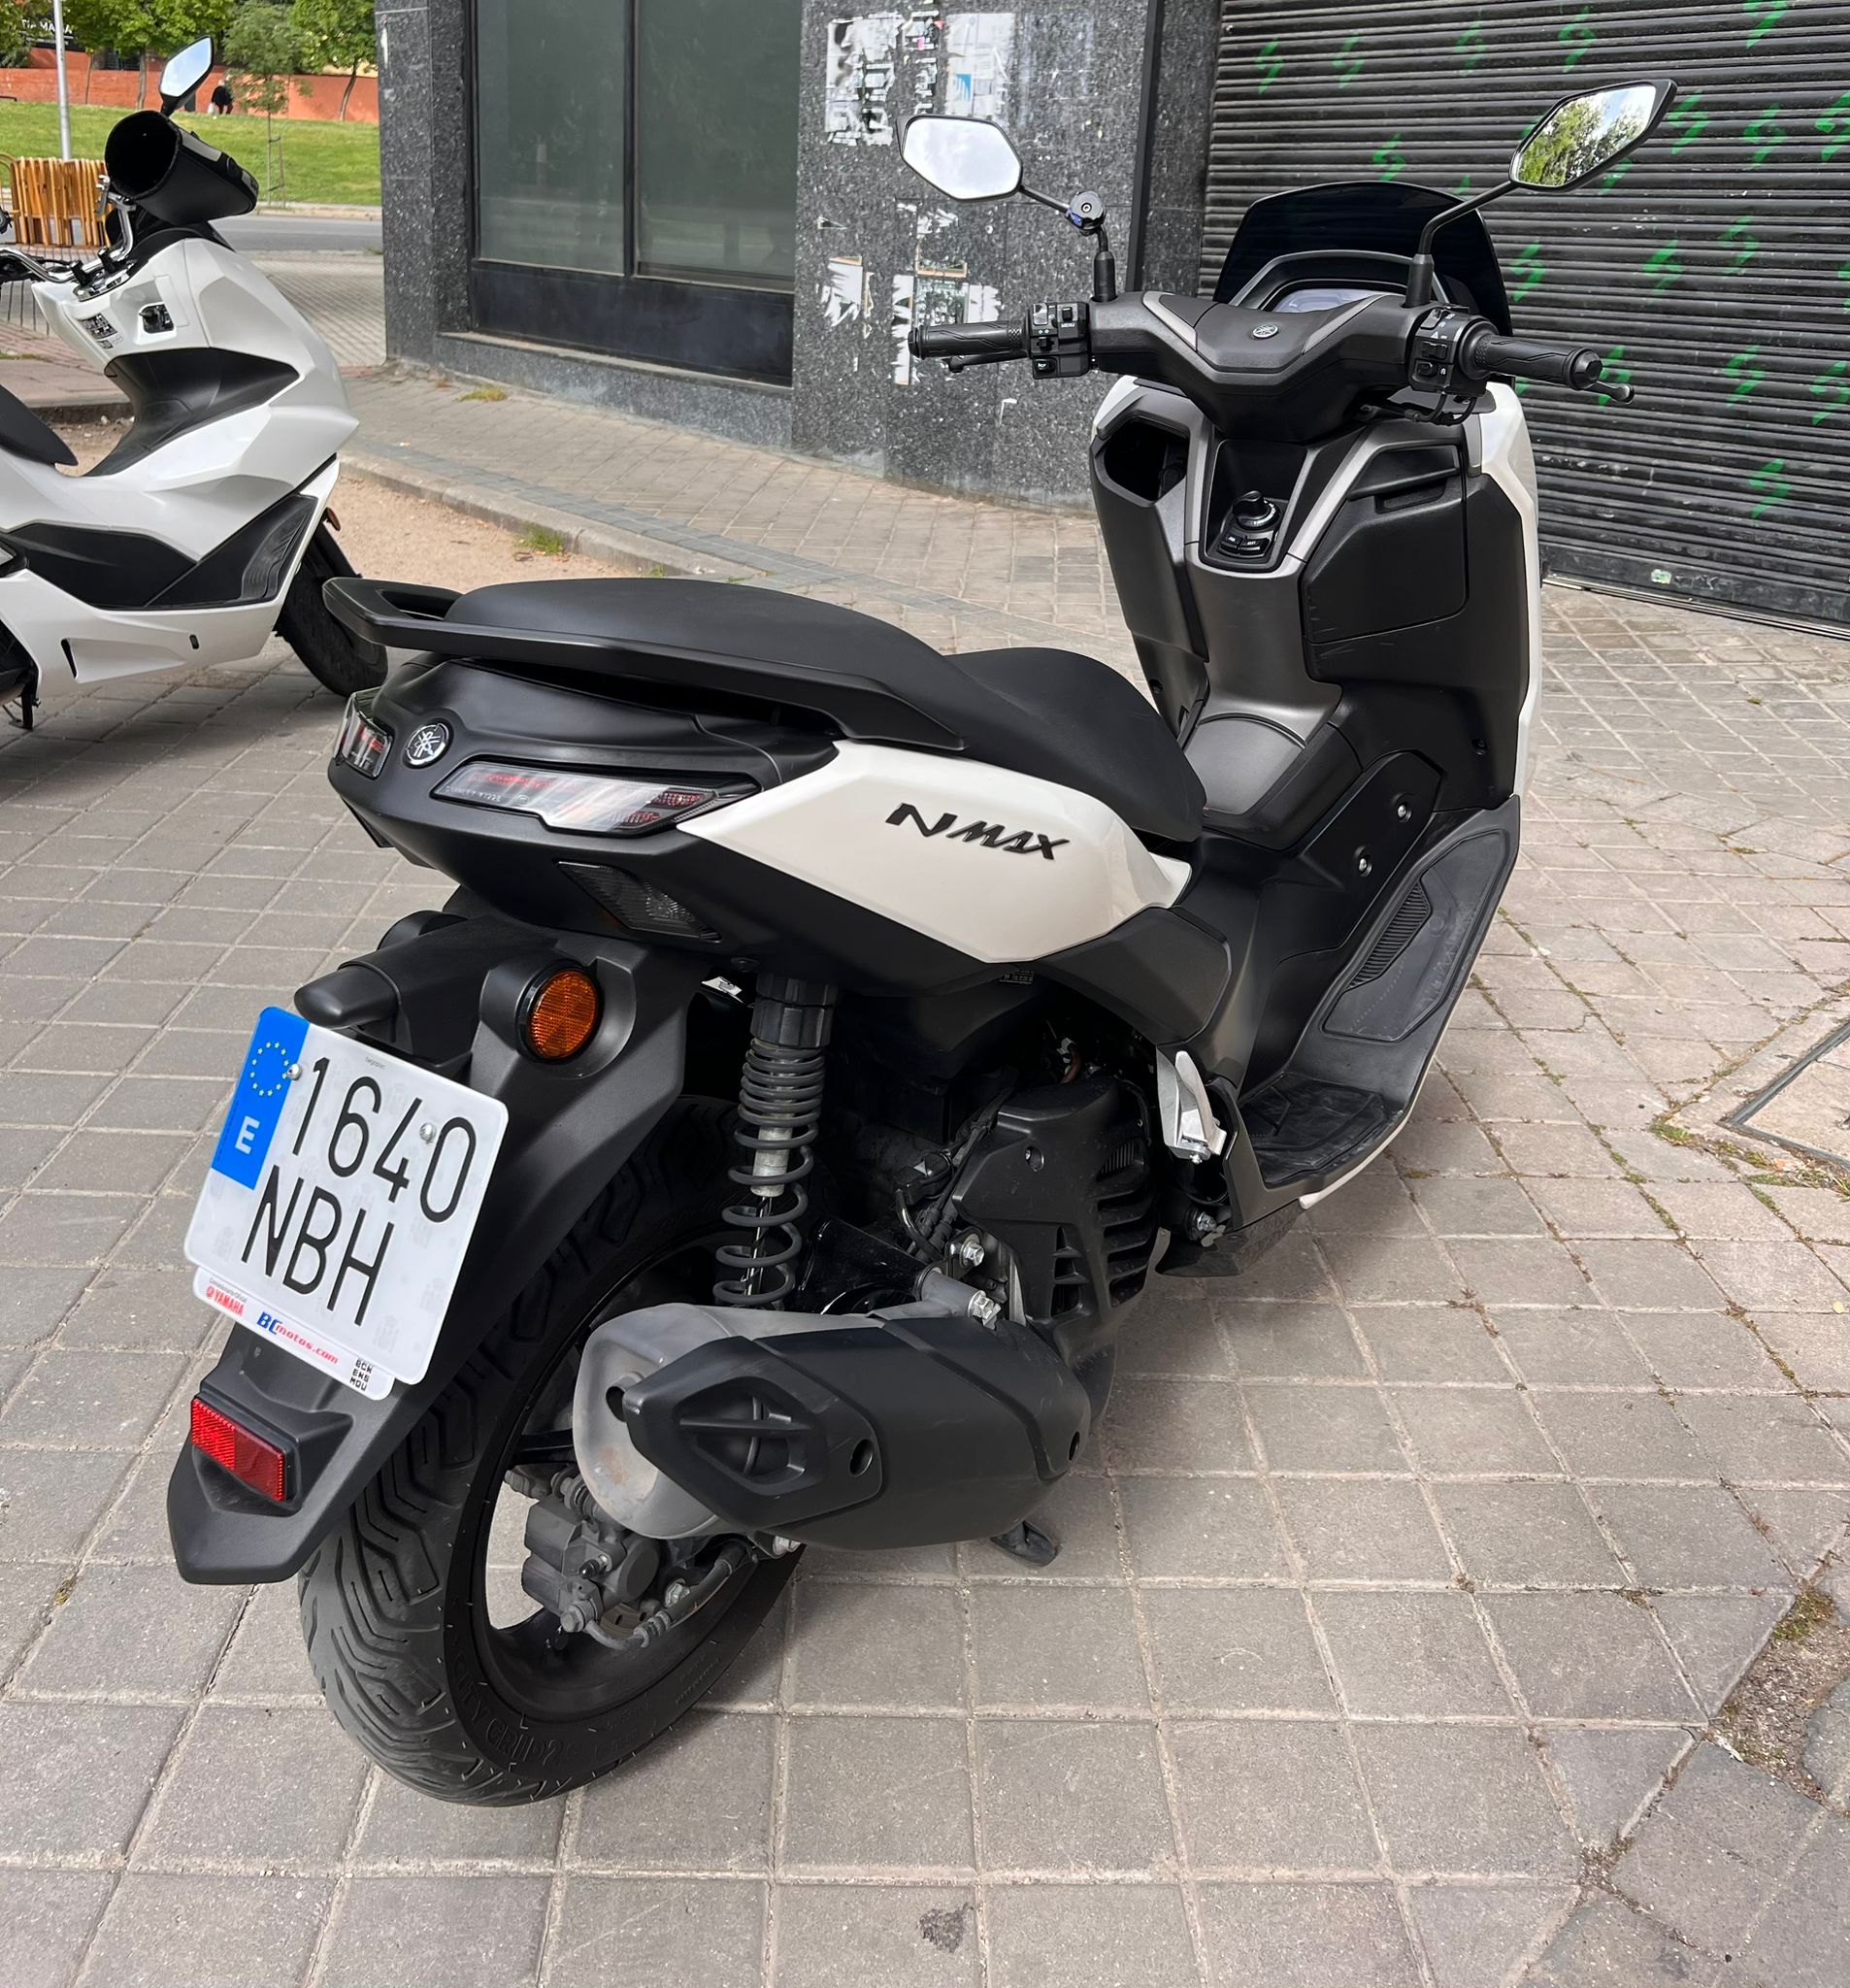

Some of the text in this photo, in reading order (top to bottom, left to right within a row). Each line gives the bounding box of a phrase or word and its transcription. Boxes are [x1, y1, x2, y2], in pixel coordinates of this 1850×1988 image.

[885, 803, 1070, 860] NMAX
[235, 1115, 260, 1155] E
[292, 1056, 478, 1224] 1640
[241, 1165, 395, 1327] NBH
[214, 1288, 246, 1317] YAMAHA
